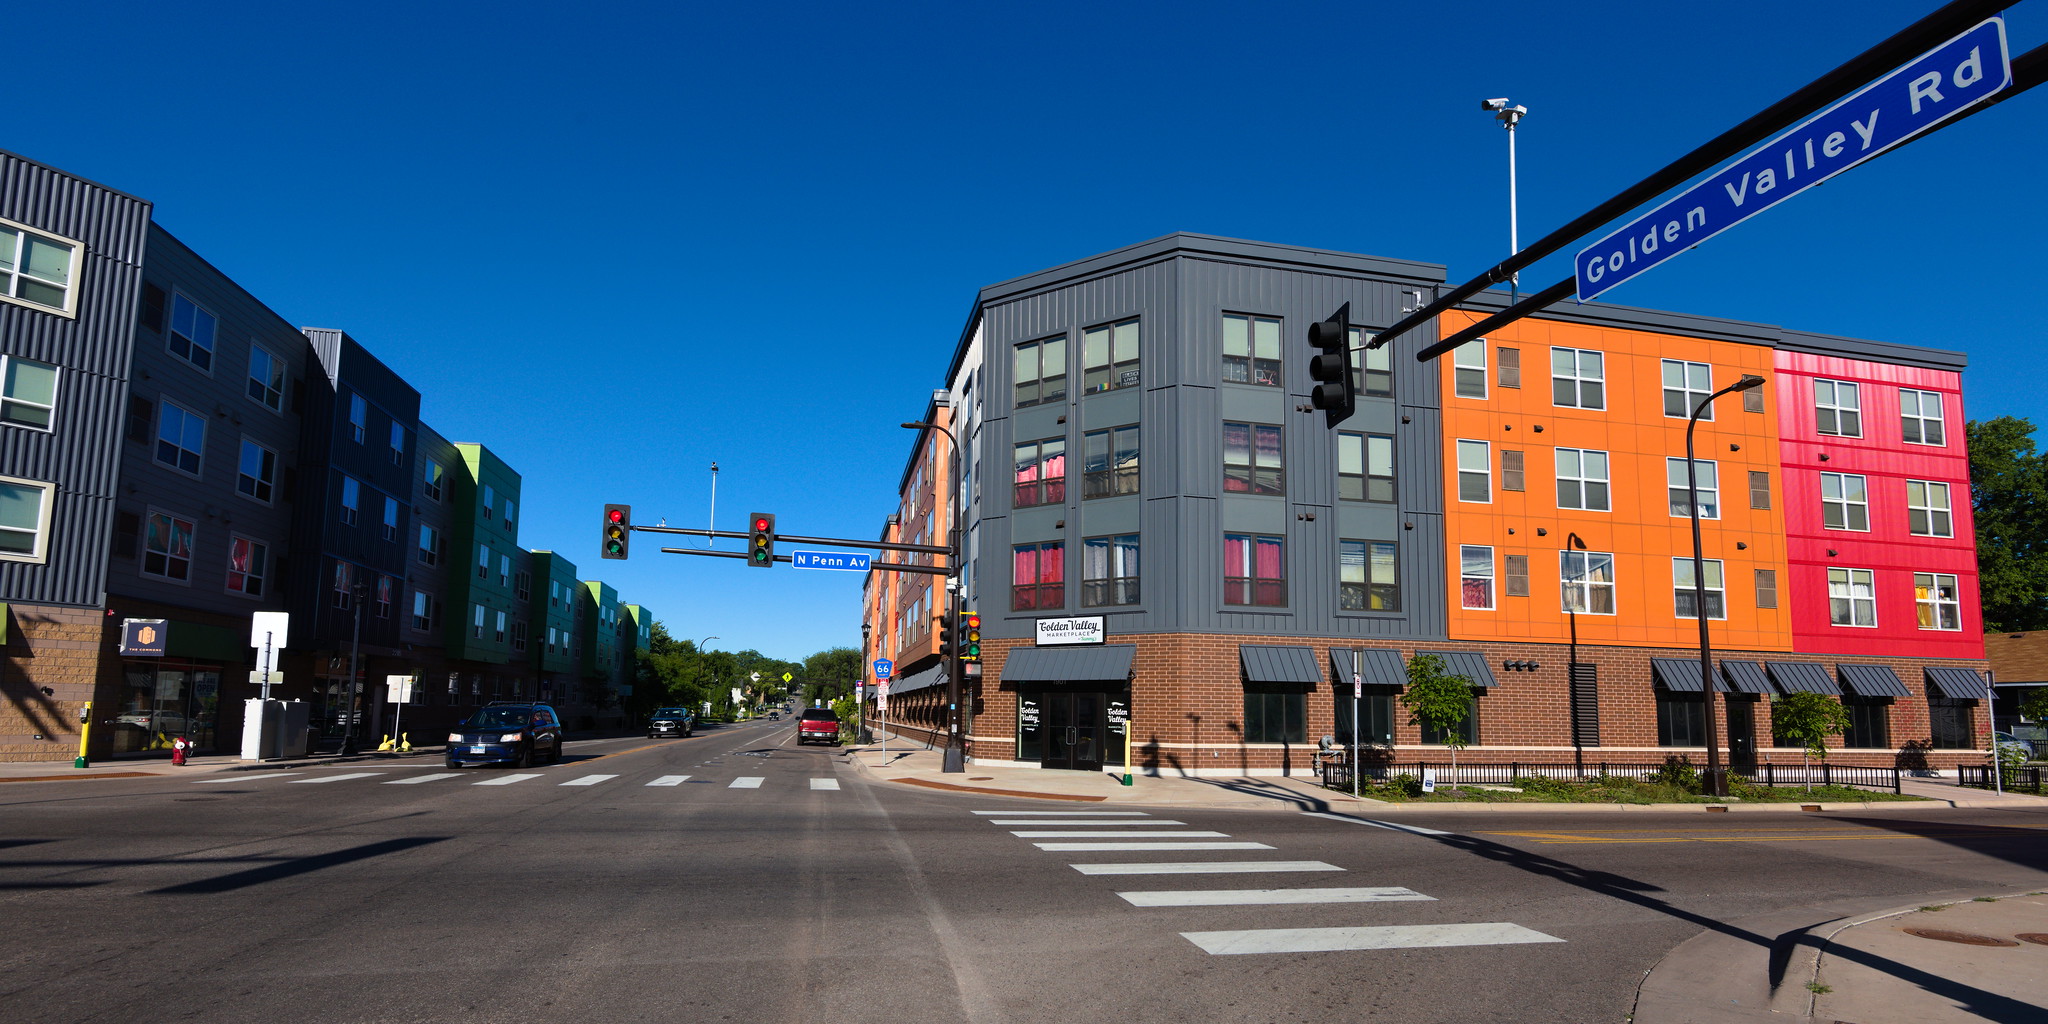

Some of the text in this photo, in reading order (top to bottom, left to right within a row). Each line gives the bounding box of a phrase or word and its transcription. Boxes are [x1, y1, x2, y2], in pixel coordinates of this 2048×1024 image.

[1587, 45, 1984, 283] Golden Valley Rd
[797, 555, 866, 567] N Penn Av
[1039, 620, 1101, 634] Golden Valley
[877, 664, 889, 673] 66
[197, 684, 216, 692] OPEN
[1107, 707, 1128, 716] Golden
[1107, 715, 1127, 725] Valley
